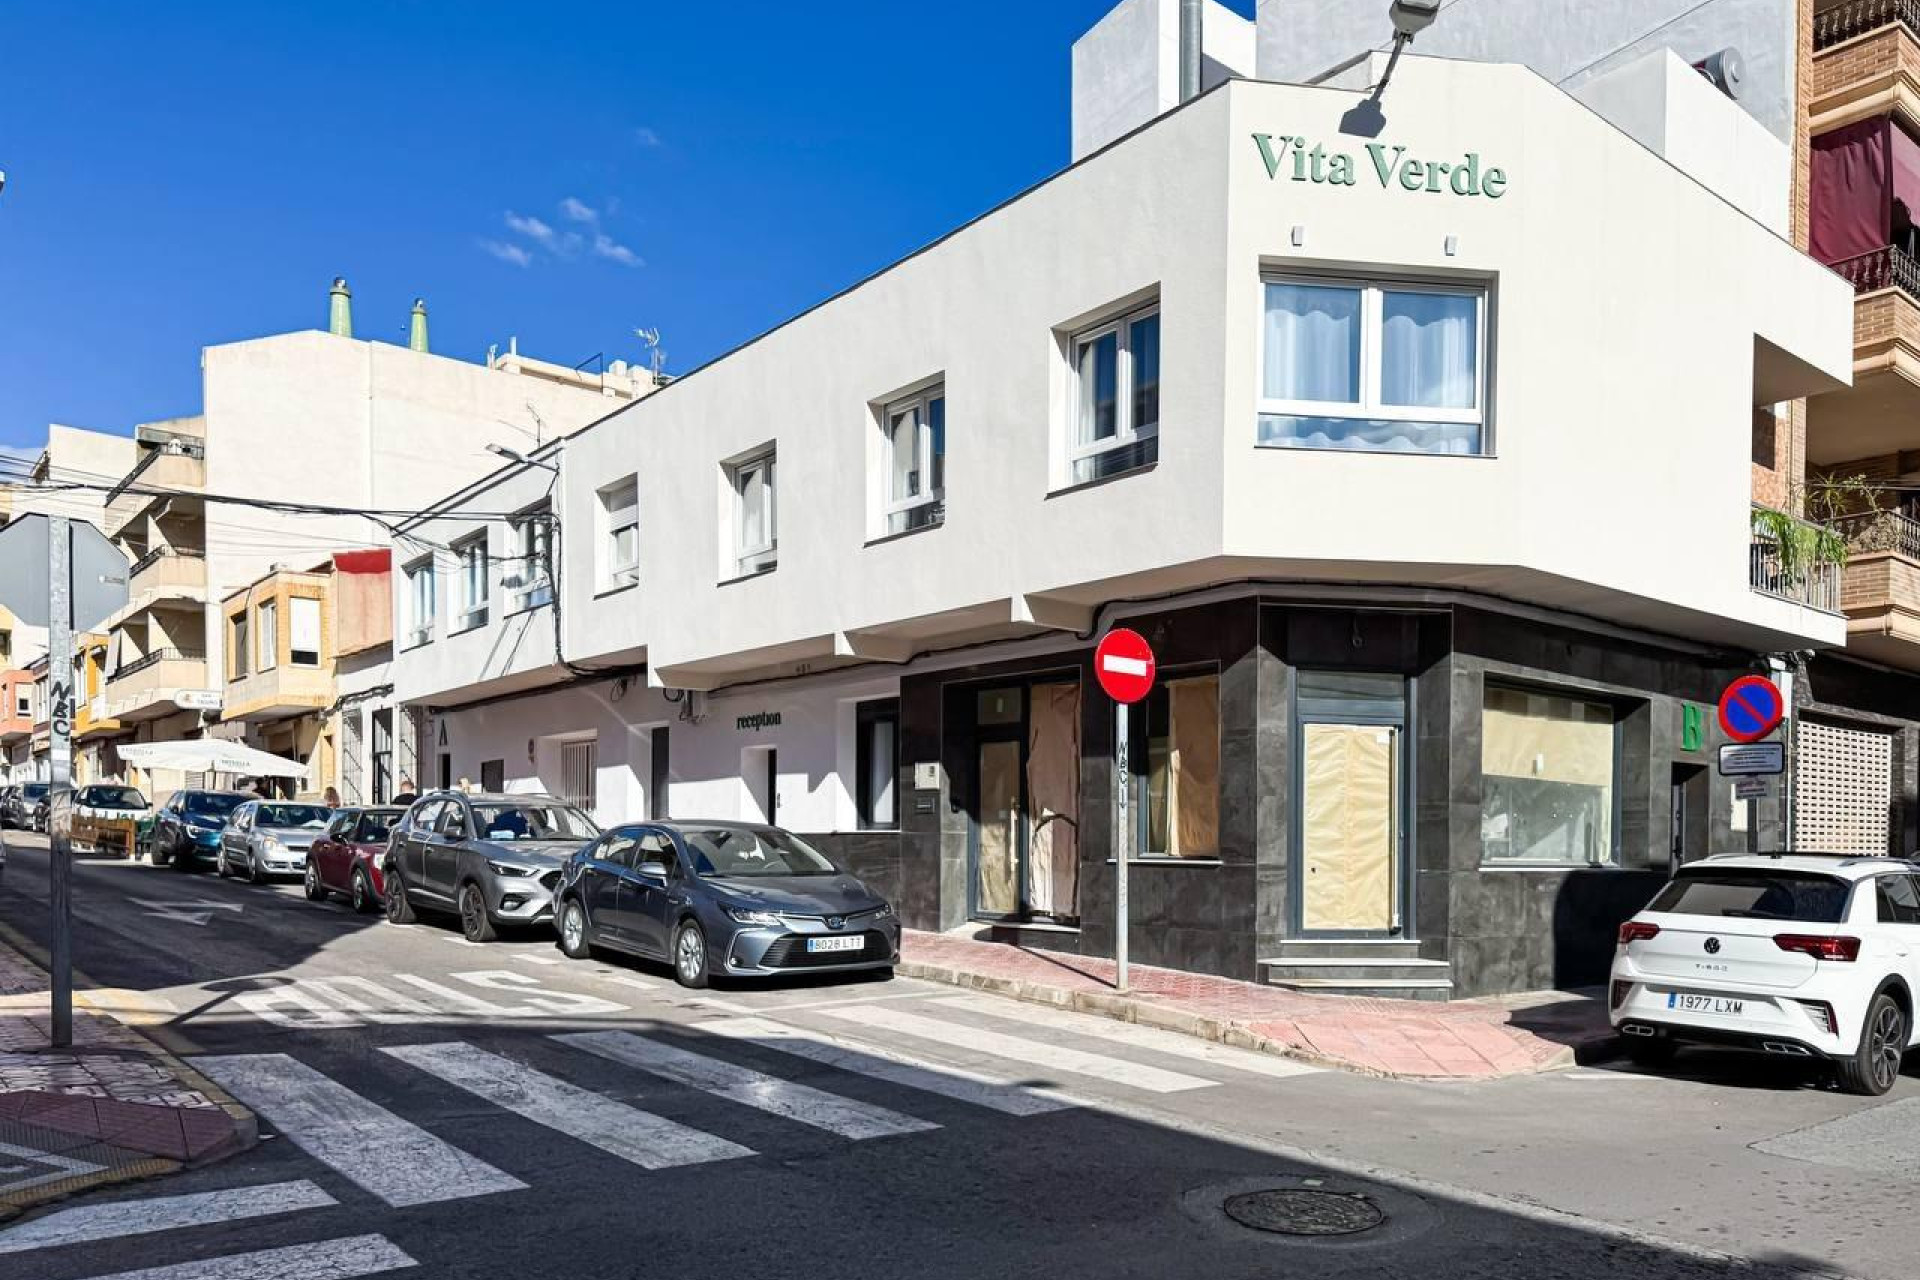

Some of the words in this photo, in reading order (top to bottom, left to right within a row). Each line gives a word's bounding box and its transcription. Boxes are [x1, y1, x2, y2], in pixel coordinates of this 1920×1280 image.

[1251, 132, 1356, 186] Vita
[1364, 142, 1507, 198] Verde
[737, 711, 782, 731] reception
[1680, 702, 1702, 751] B
[1680, 994, 1712, 1010] 1977
[1715, 999, 1743, 1014] LXM
